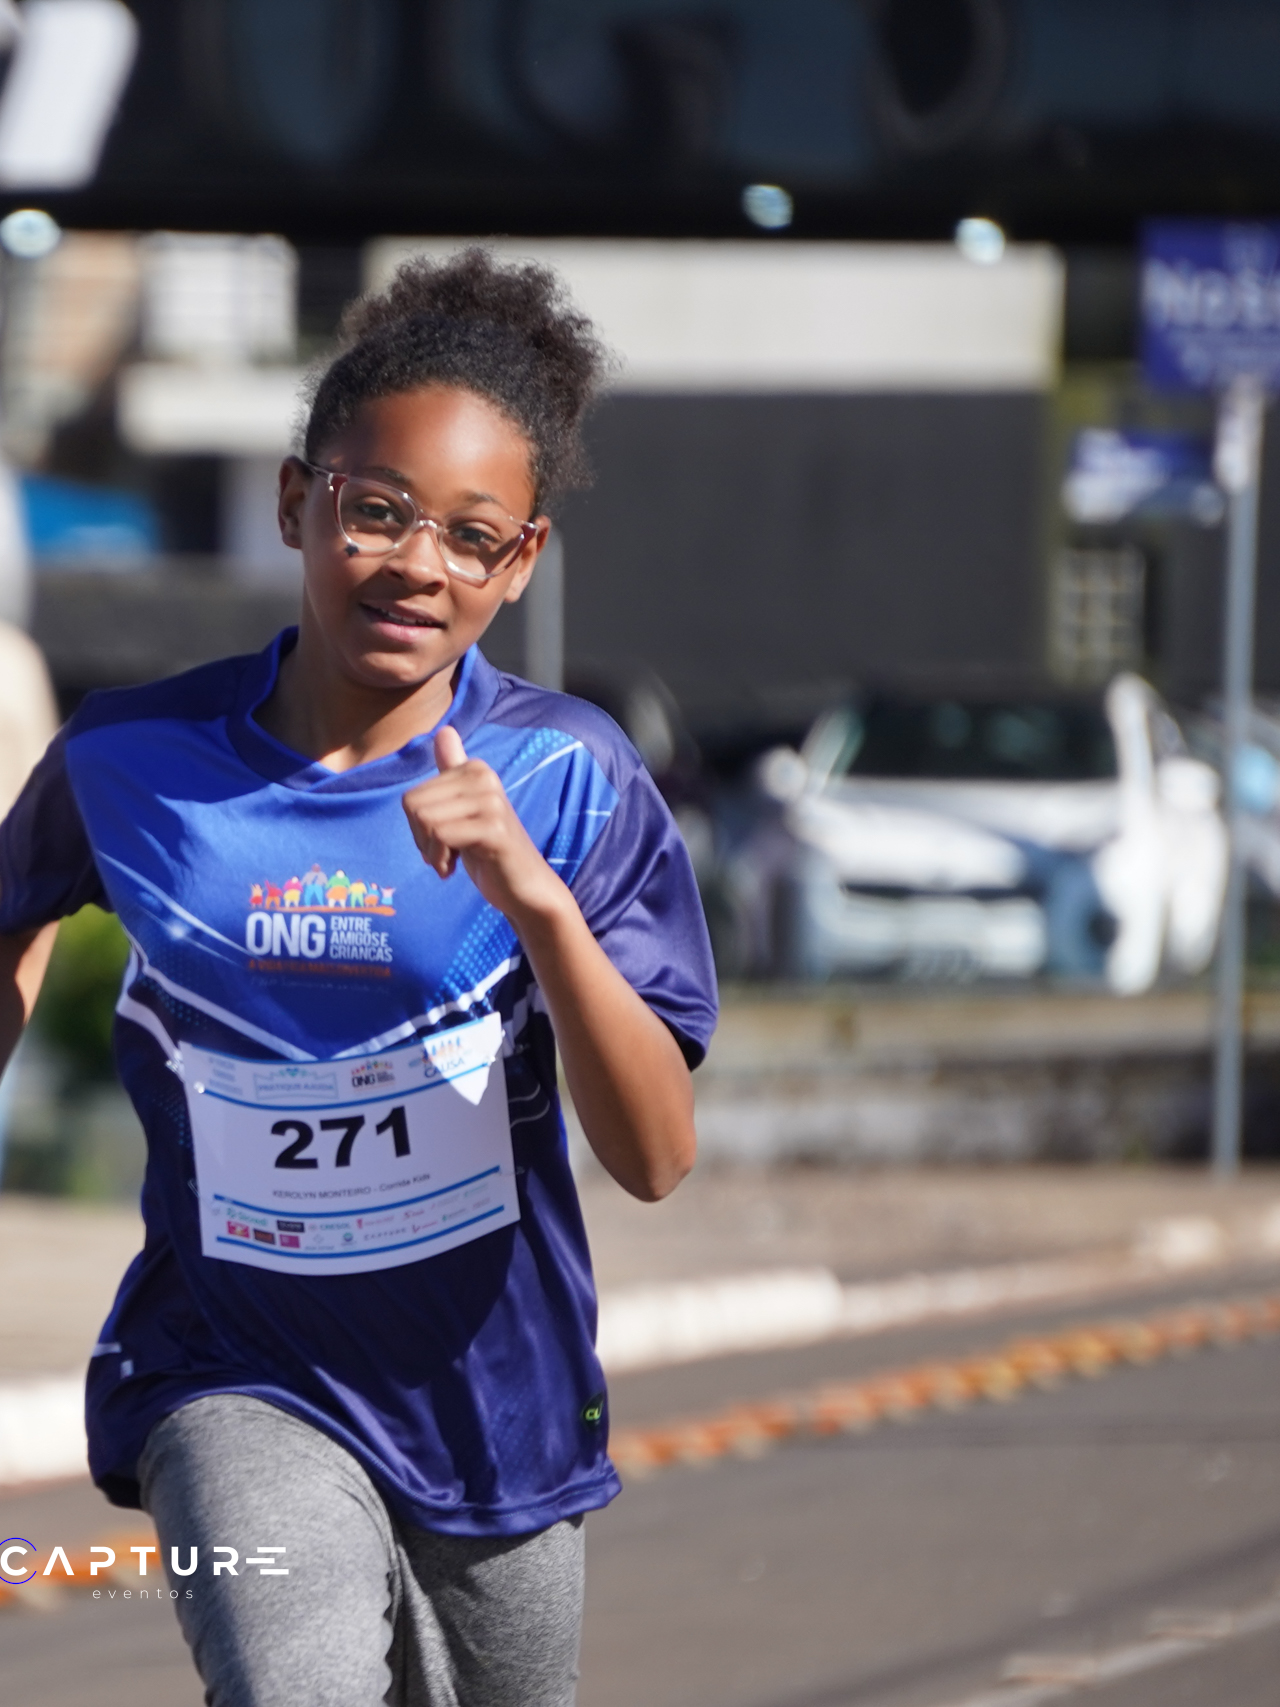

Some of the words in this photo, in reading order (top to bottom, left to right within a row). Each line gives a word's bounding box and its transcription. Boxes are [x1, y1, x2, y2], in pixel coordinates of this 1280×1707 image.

[246, 911, 326, 959] ONG
[331, 915, 372, 932] ENTRE
[271, 1106, 411, 1169] 271
[272, 1189, 316, 1200] KEROLYN
[319, 1186, 371, 1200] MONTEIRO
[379, 1179, 410, 1192] Corrida
[412, 1174, 431, 1187] Kids
